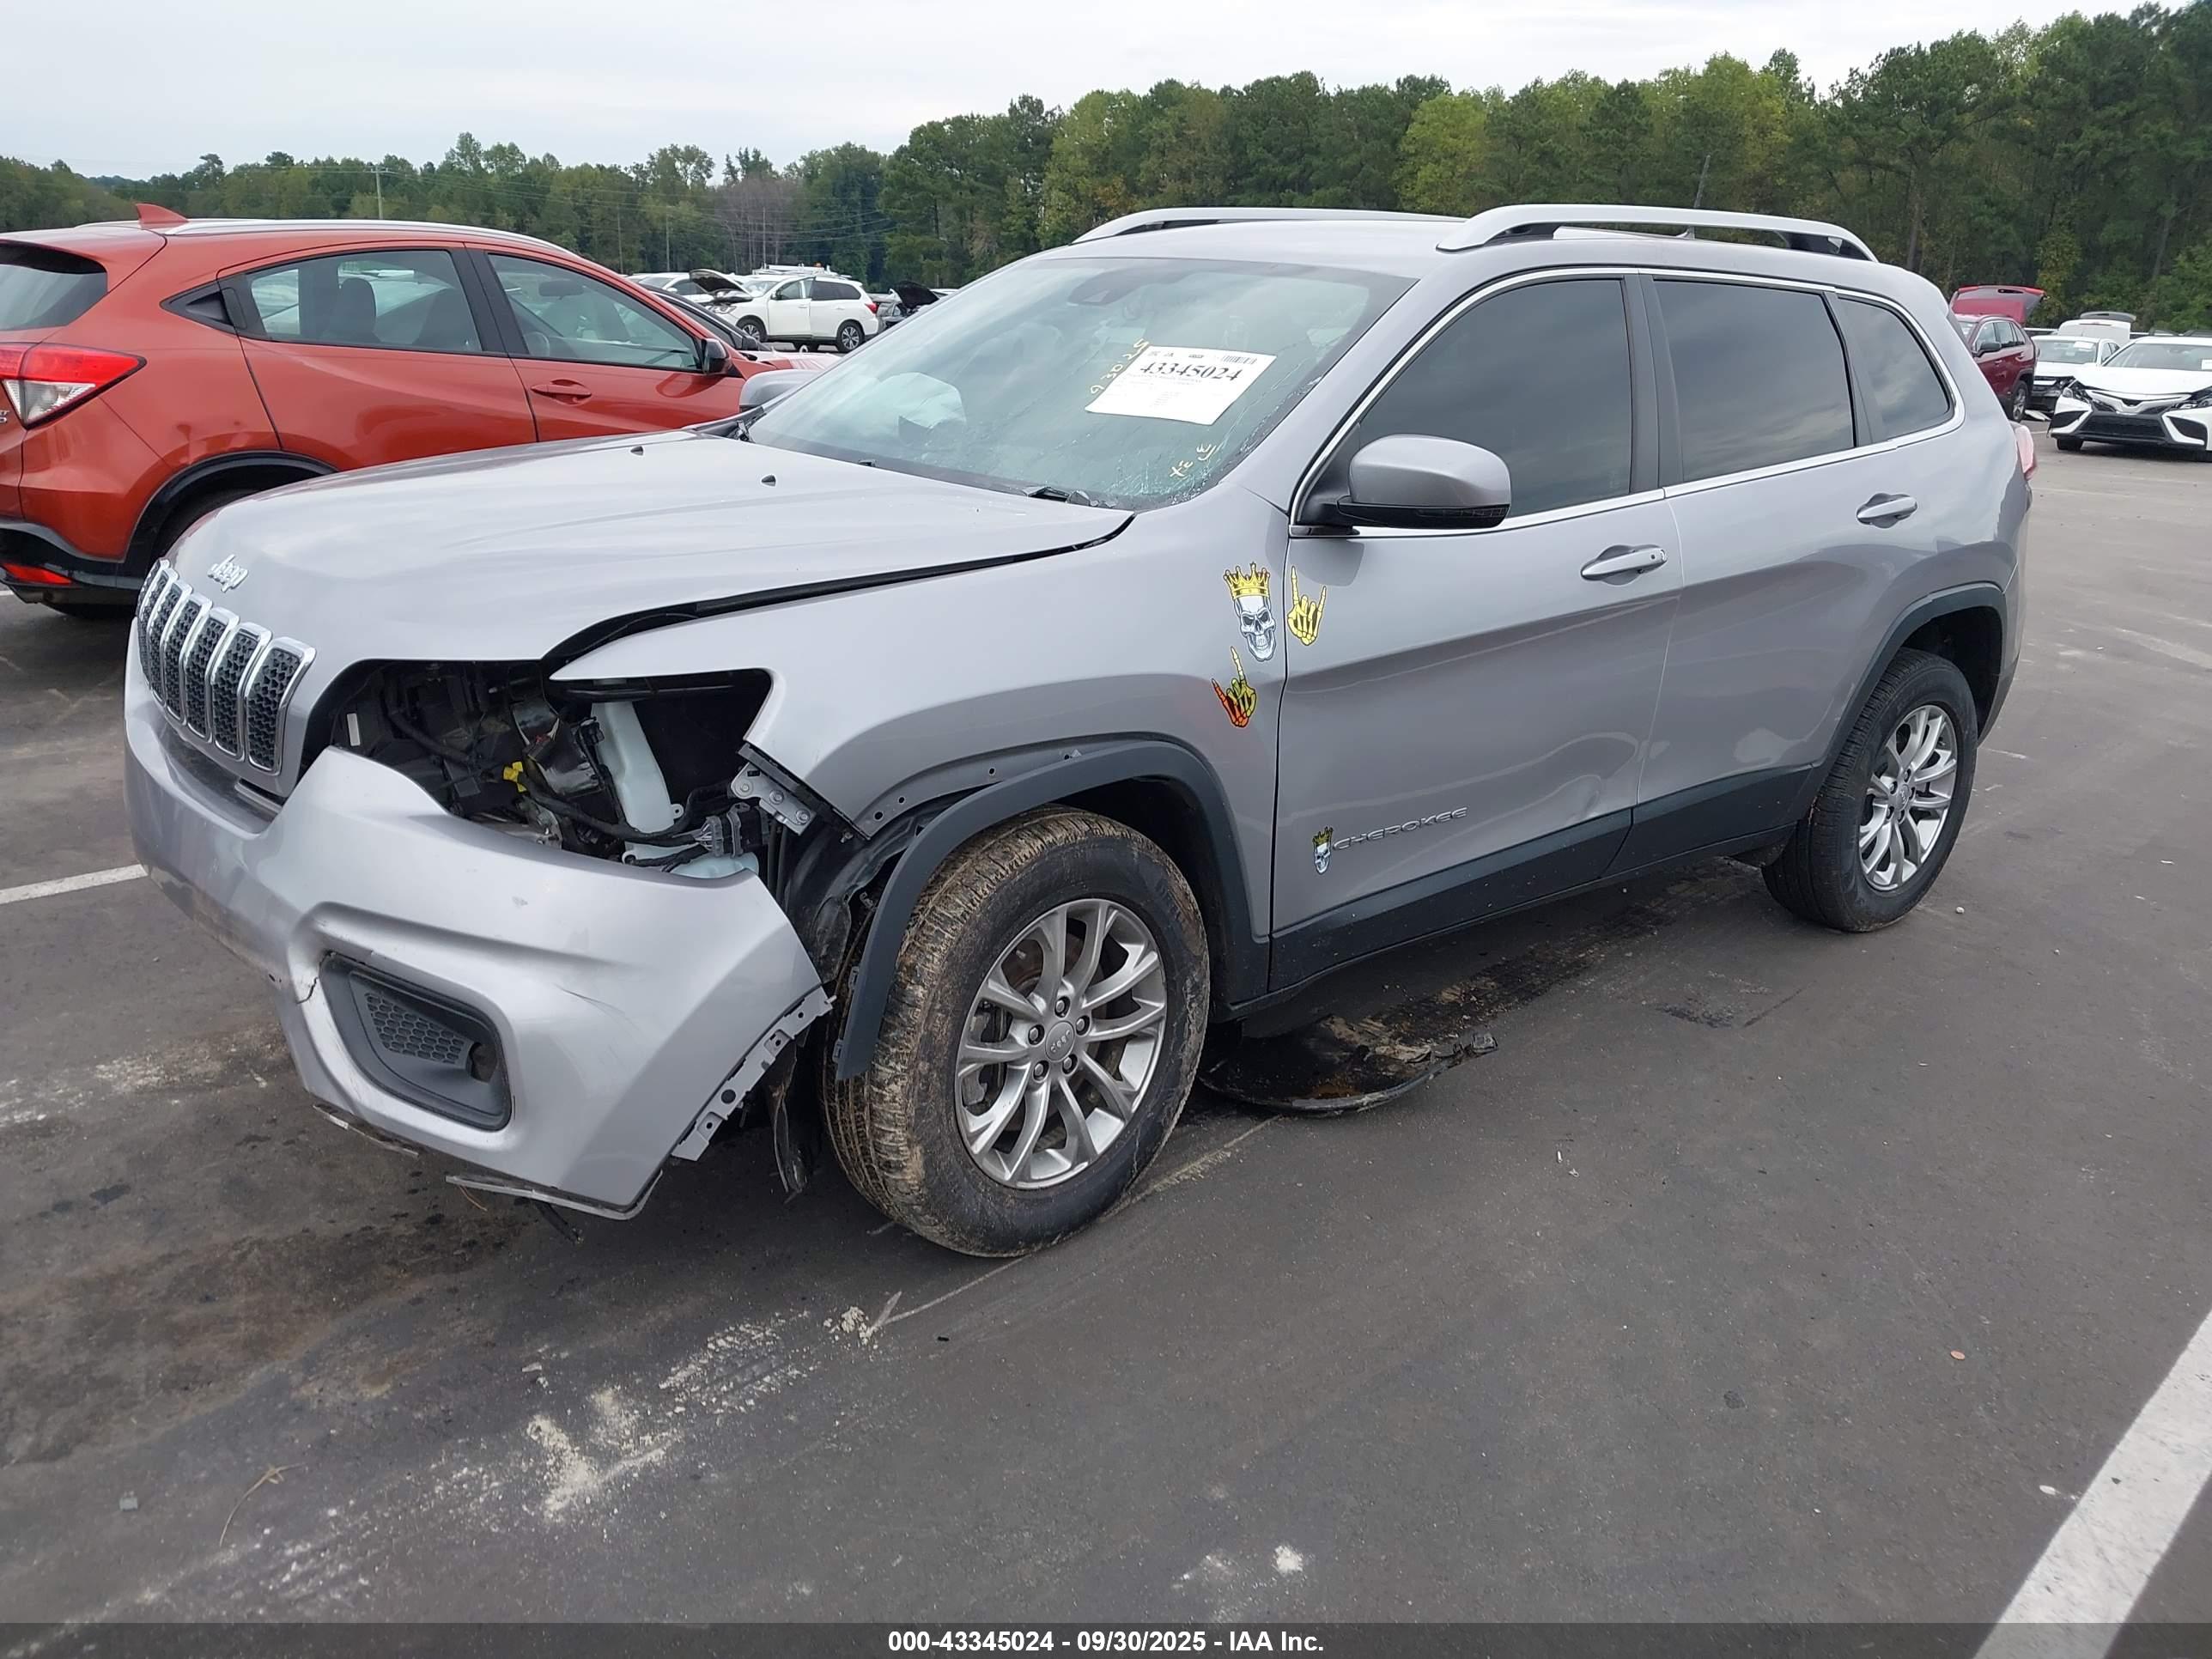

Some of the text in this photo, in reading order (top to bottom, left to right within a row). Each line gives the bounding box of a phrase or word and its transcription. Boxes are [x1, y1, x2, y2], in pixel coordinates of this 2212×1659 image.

[1140, 361, 1243, 381] 43345024
[206, 553, 249, 594] Jeep
[1332, 806, 1468, 850] CHEROKEE
